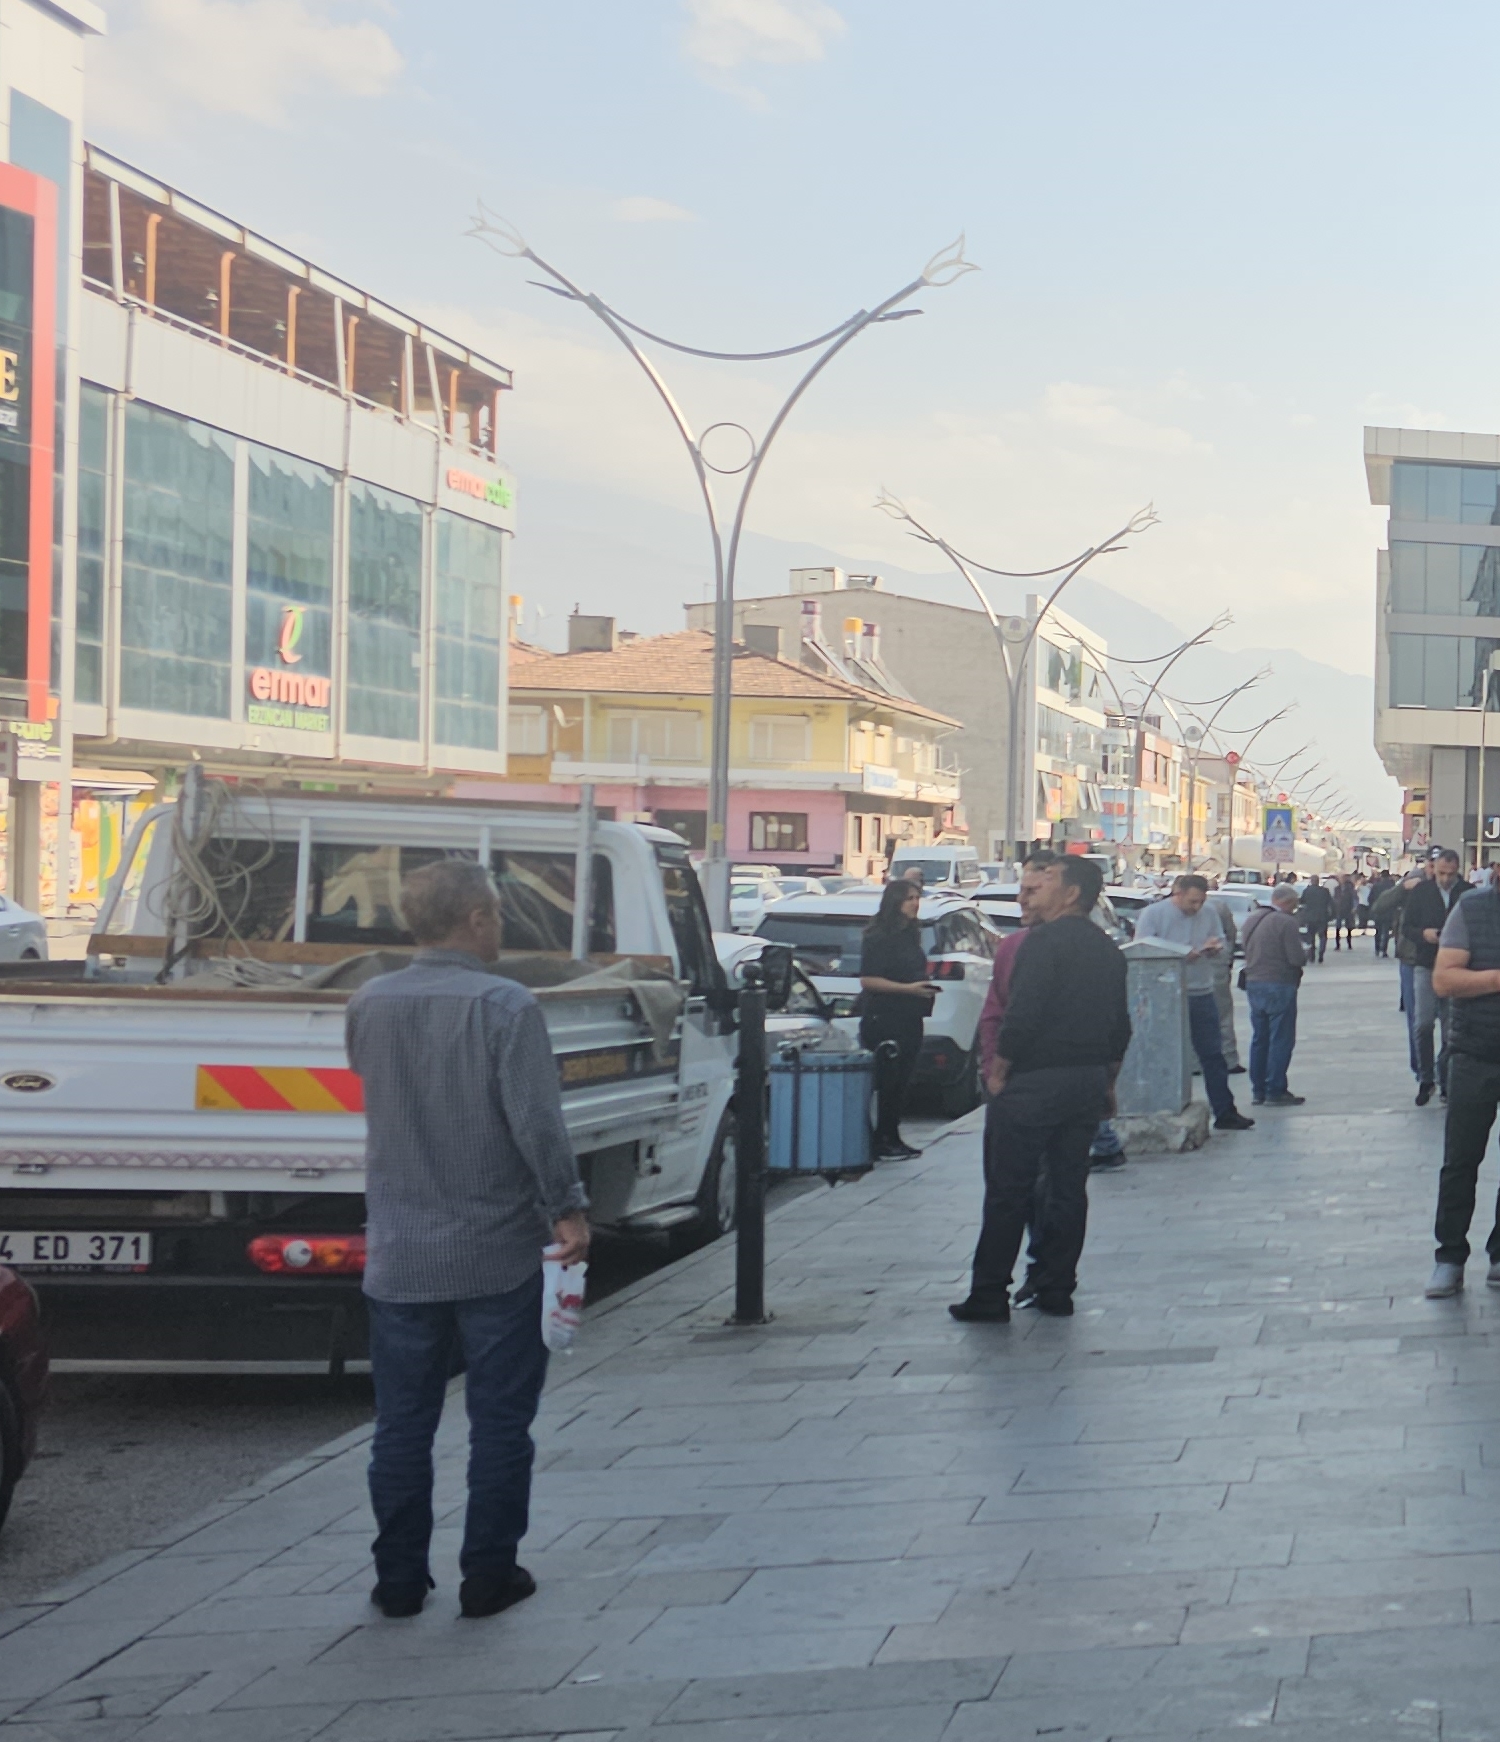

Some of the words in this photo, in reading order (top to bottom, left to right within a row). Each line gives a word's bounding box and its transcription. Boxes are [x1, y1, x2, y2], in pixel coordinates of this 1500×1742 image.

[250, 667, 330, 707] ermar
[33, 1235, 69, 1260] ED
[89, 1235, 141, 1260] 371
